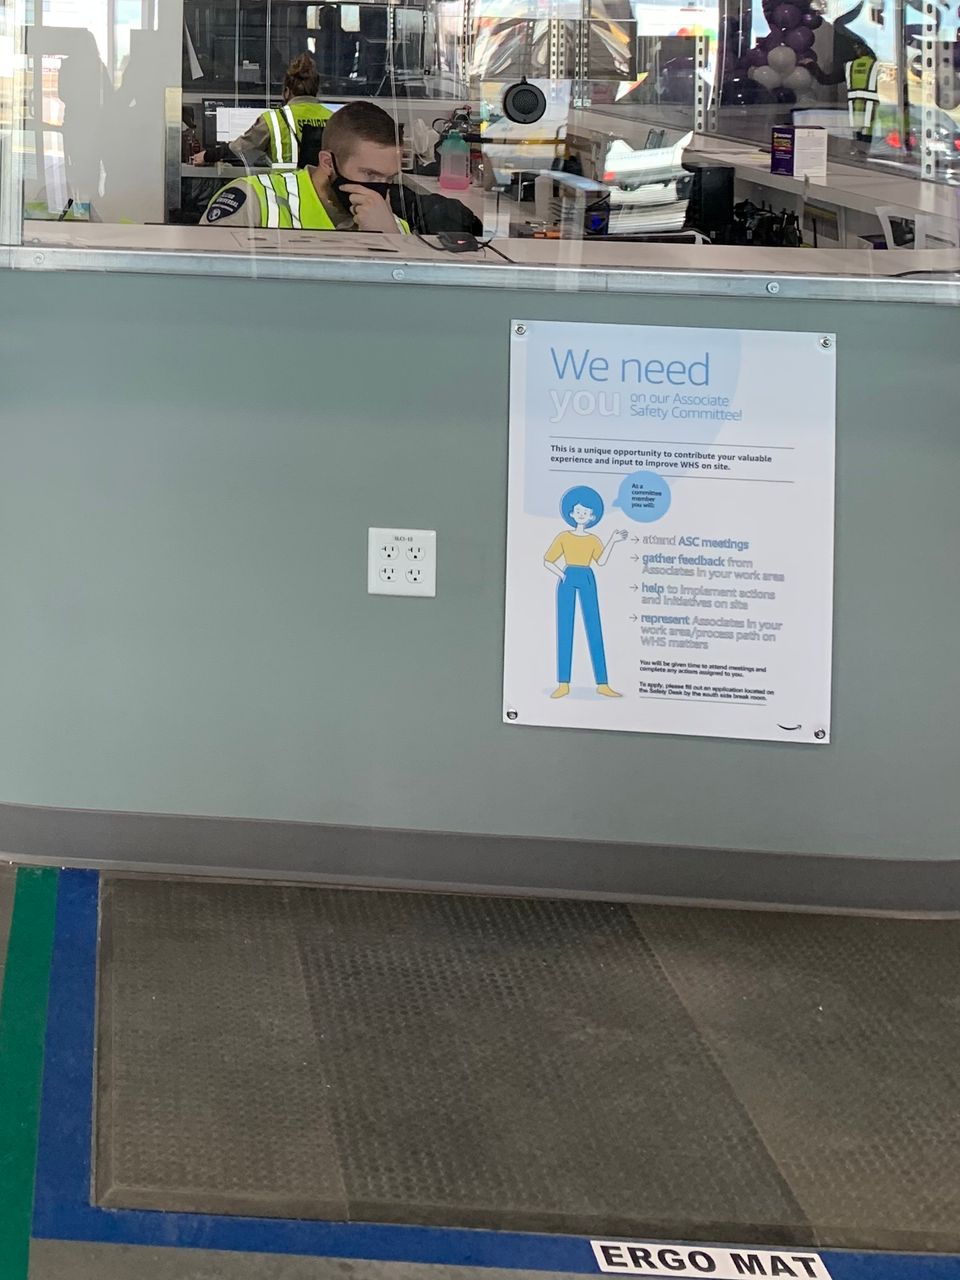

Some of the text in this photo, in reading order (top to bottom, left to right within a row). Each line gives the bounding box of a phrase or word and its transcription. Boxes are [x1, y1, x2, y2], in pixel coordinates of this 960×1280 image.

[551, 347, 709, 386] We need
[549, 389, 621, 423] you
[631, 393, 728, 406] on our Associate
[631, 405, 742, 420] Safety Committee!
[584, 447, 611, 455] unique
[614, 449, 661, 458] opportunity
[674, 451, 715, 459] contribute
[738, 454, 772, 463] valuable
[551, 456, 592, 464] experience
[612, 458, 632, 466] input
[646, 459, 678, 469] improve
[714, 462, 731, 470] site.
[643, 535, 749, 551] attend ASC meetings
[643, 554, 752, 568] gather feedback from
[642, 566, 784, 582] Associates in your work area
[642, 583, 775, 599] help to implement actions
[642, 595, 748, 609] and initiatives on site
[641, 615, 783, 630] represent Associates in your
[641, 626, 776, 641] work area/process path on
[641, 636, 708, 649] WHS matters
[600, 1245, 819, 1279] ERGO MAT
